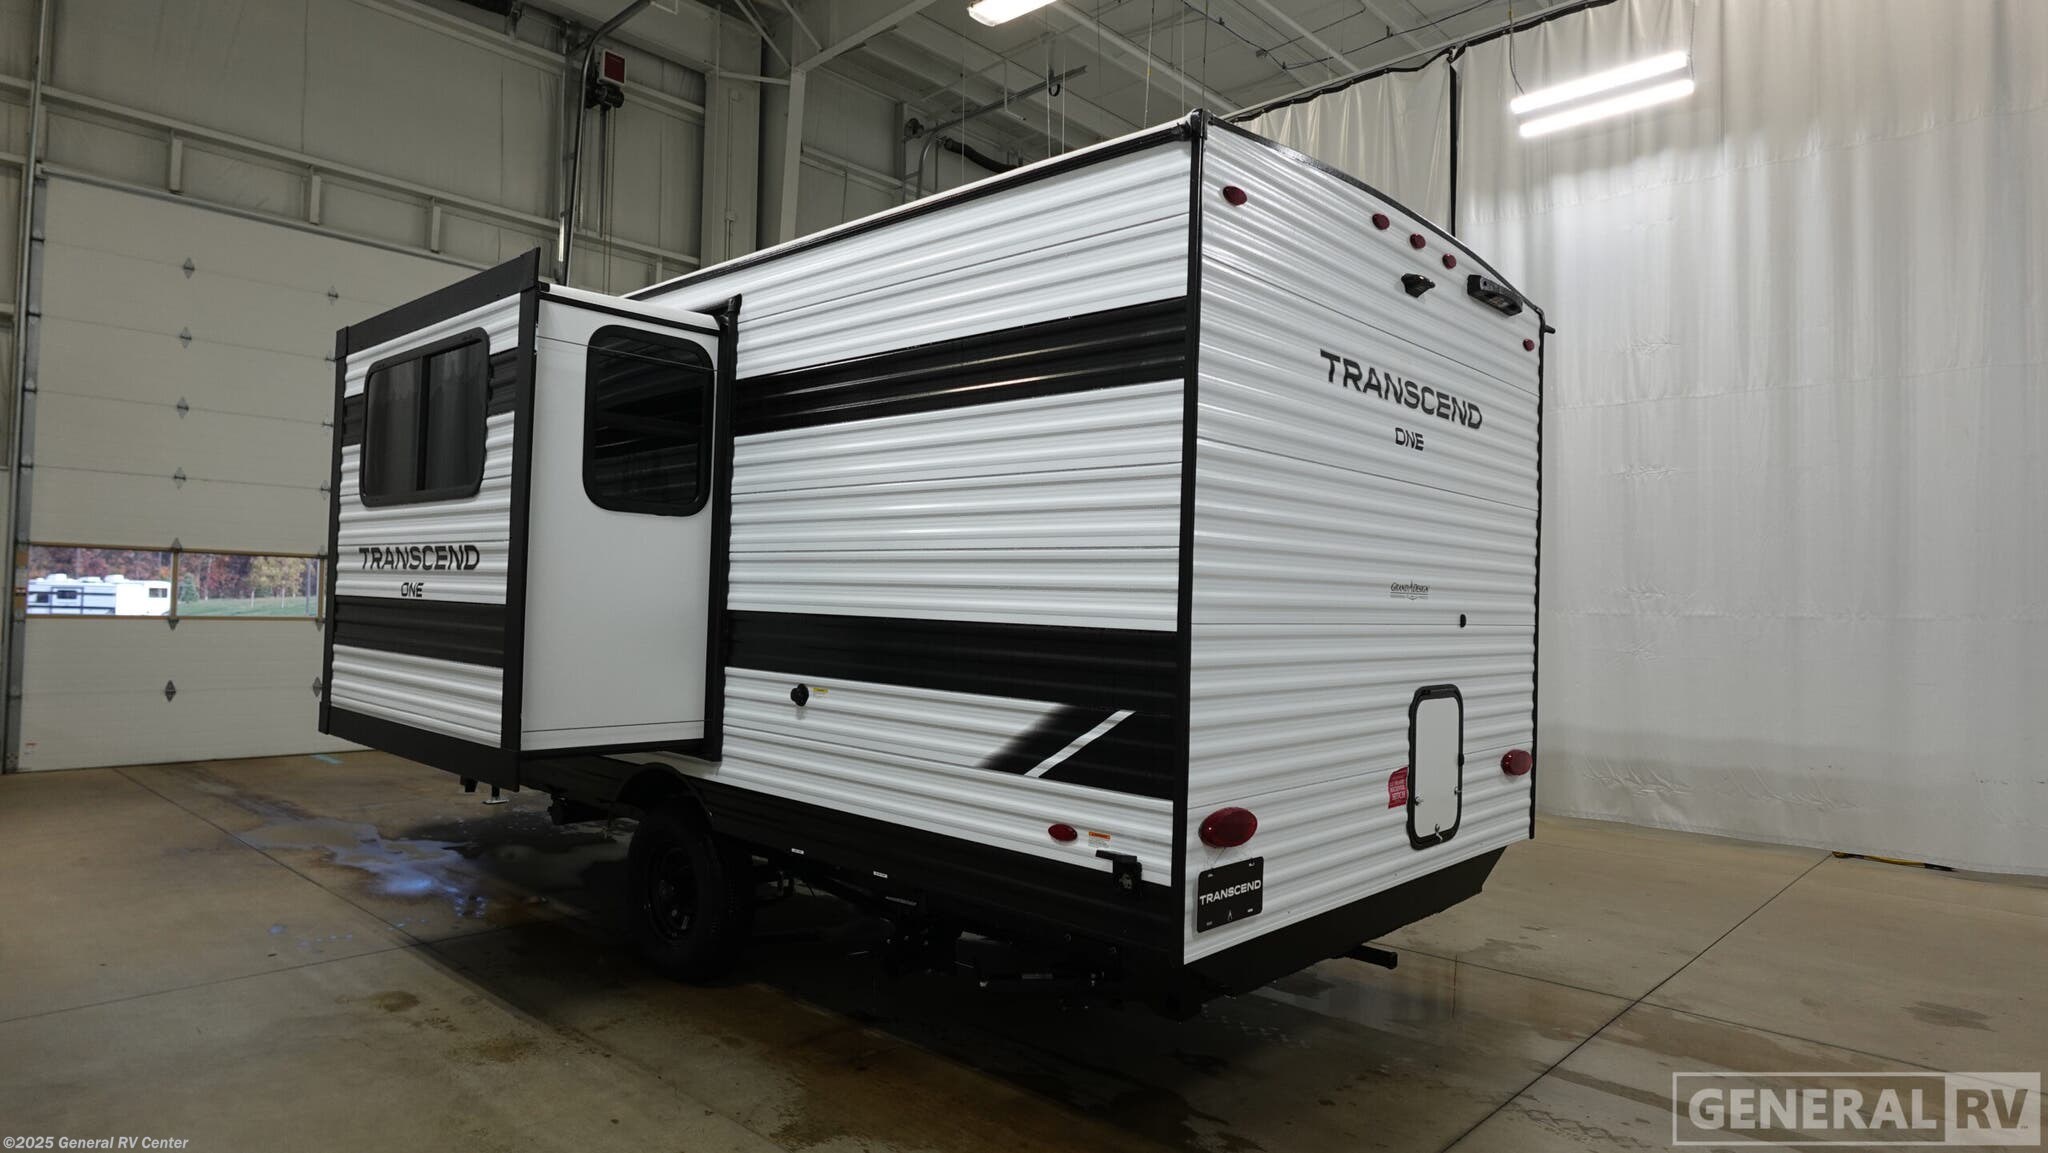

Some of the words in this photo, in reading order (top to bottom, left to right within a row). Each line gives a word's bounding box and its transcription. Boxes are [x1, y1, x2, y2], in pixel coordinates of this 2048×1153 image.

[1320, 348, 1483, 430] TRANSCEND
[358, 545, 480, 571] TRANSCEND
[400, 582, 424, 598] ONE
[1199, 879, 1262, 906] TRANSCEND
